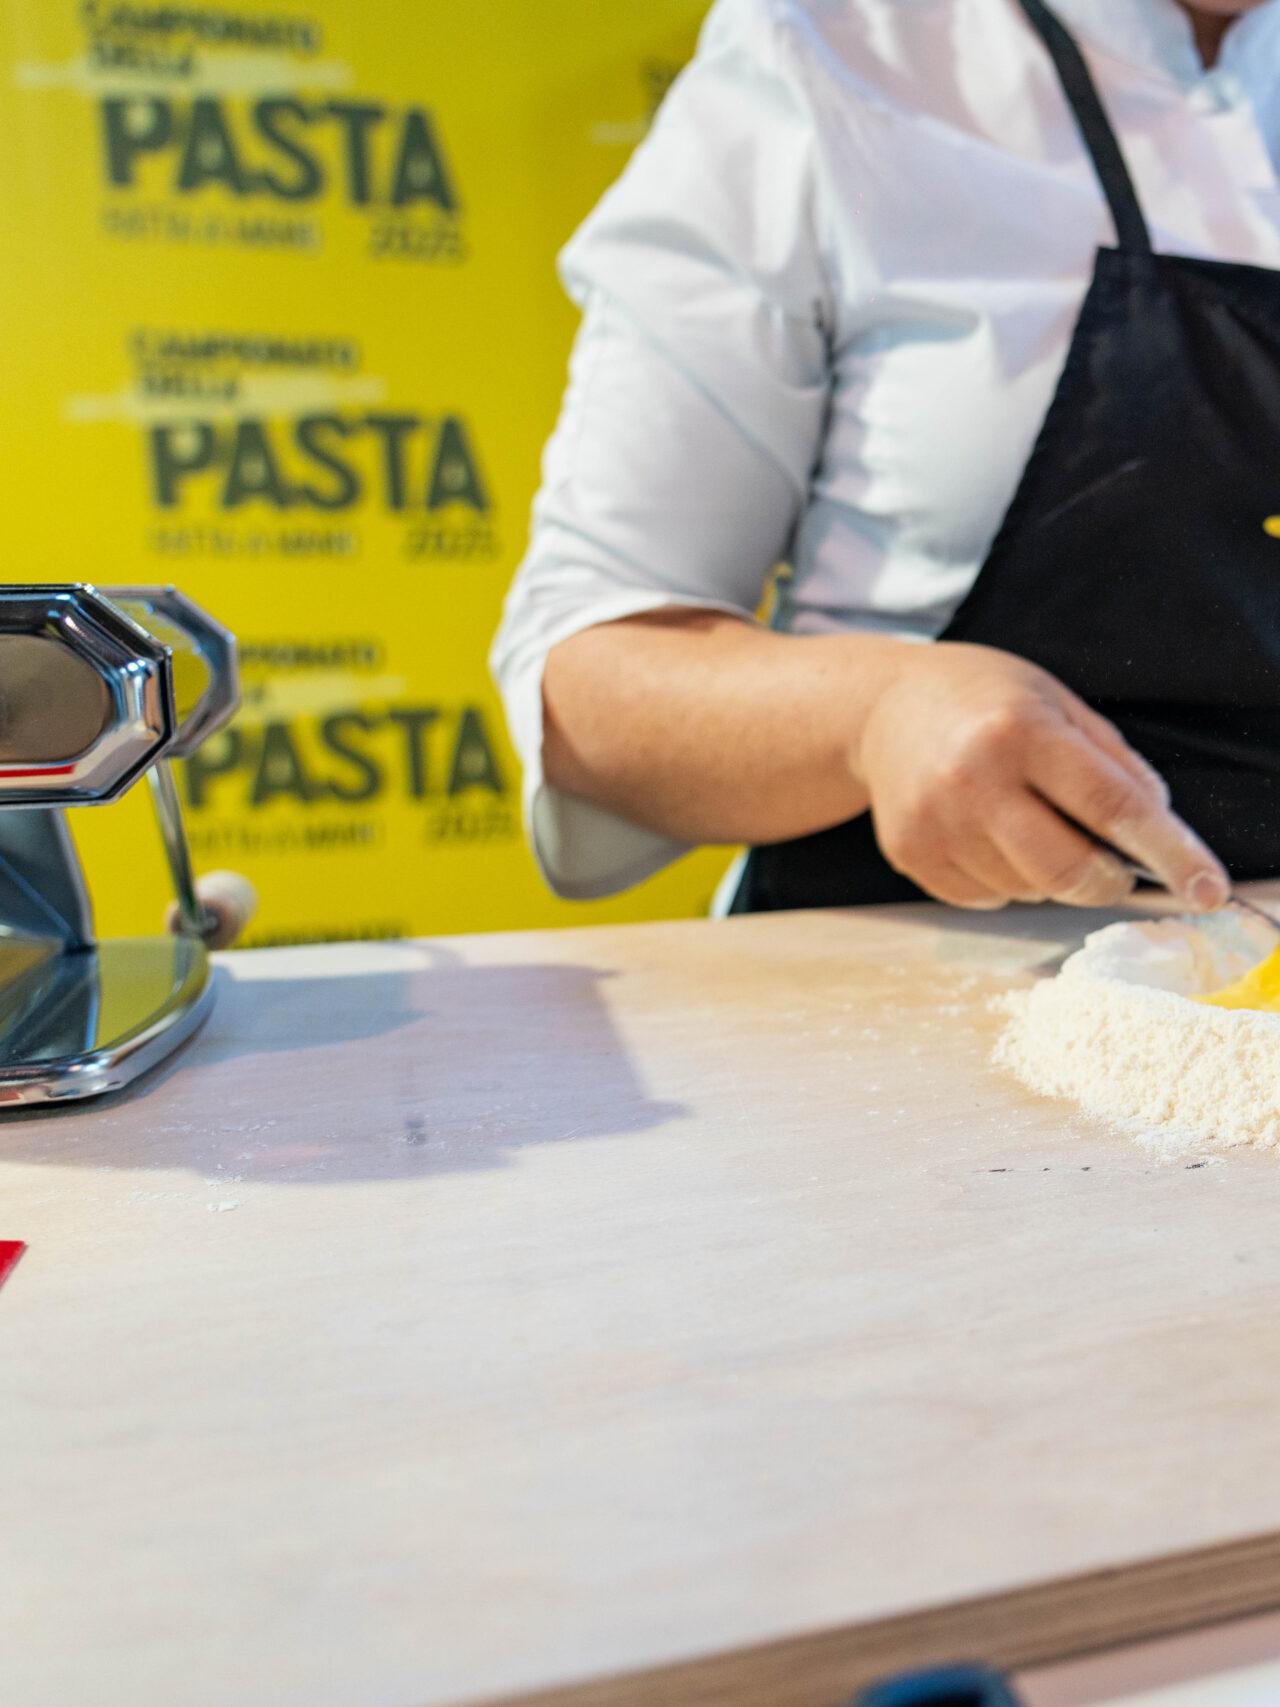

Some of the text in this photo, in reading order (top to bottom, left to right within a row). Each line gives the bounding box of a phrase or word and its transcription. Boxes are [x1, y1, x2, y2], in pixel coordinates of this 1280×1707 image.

[100, 95, 461, 214] PASTA
[150, 414, 492, 516] PASTA
[185, 703, 507, 810] PASTA
